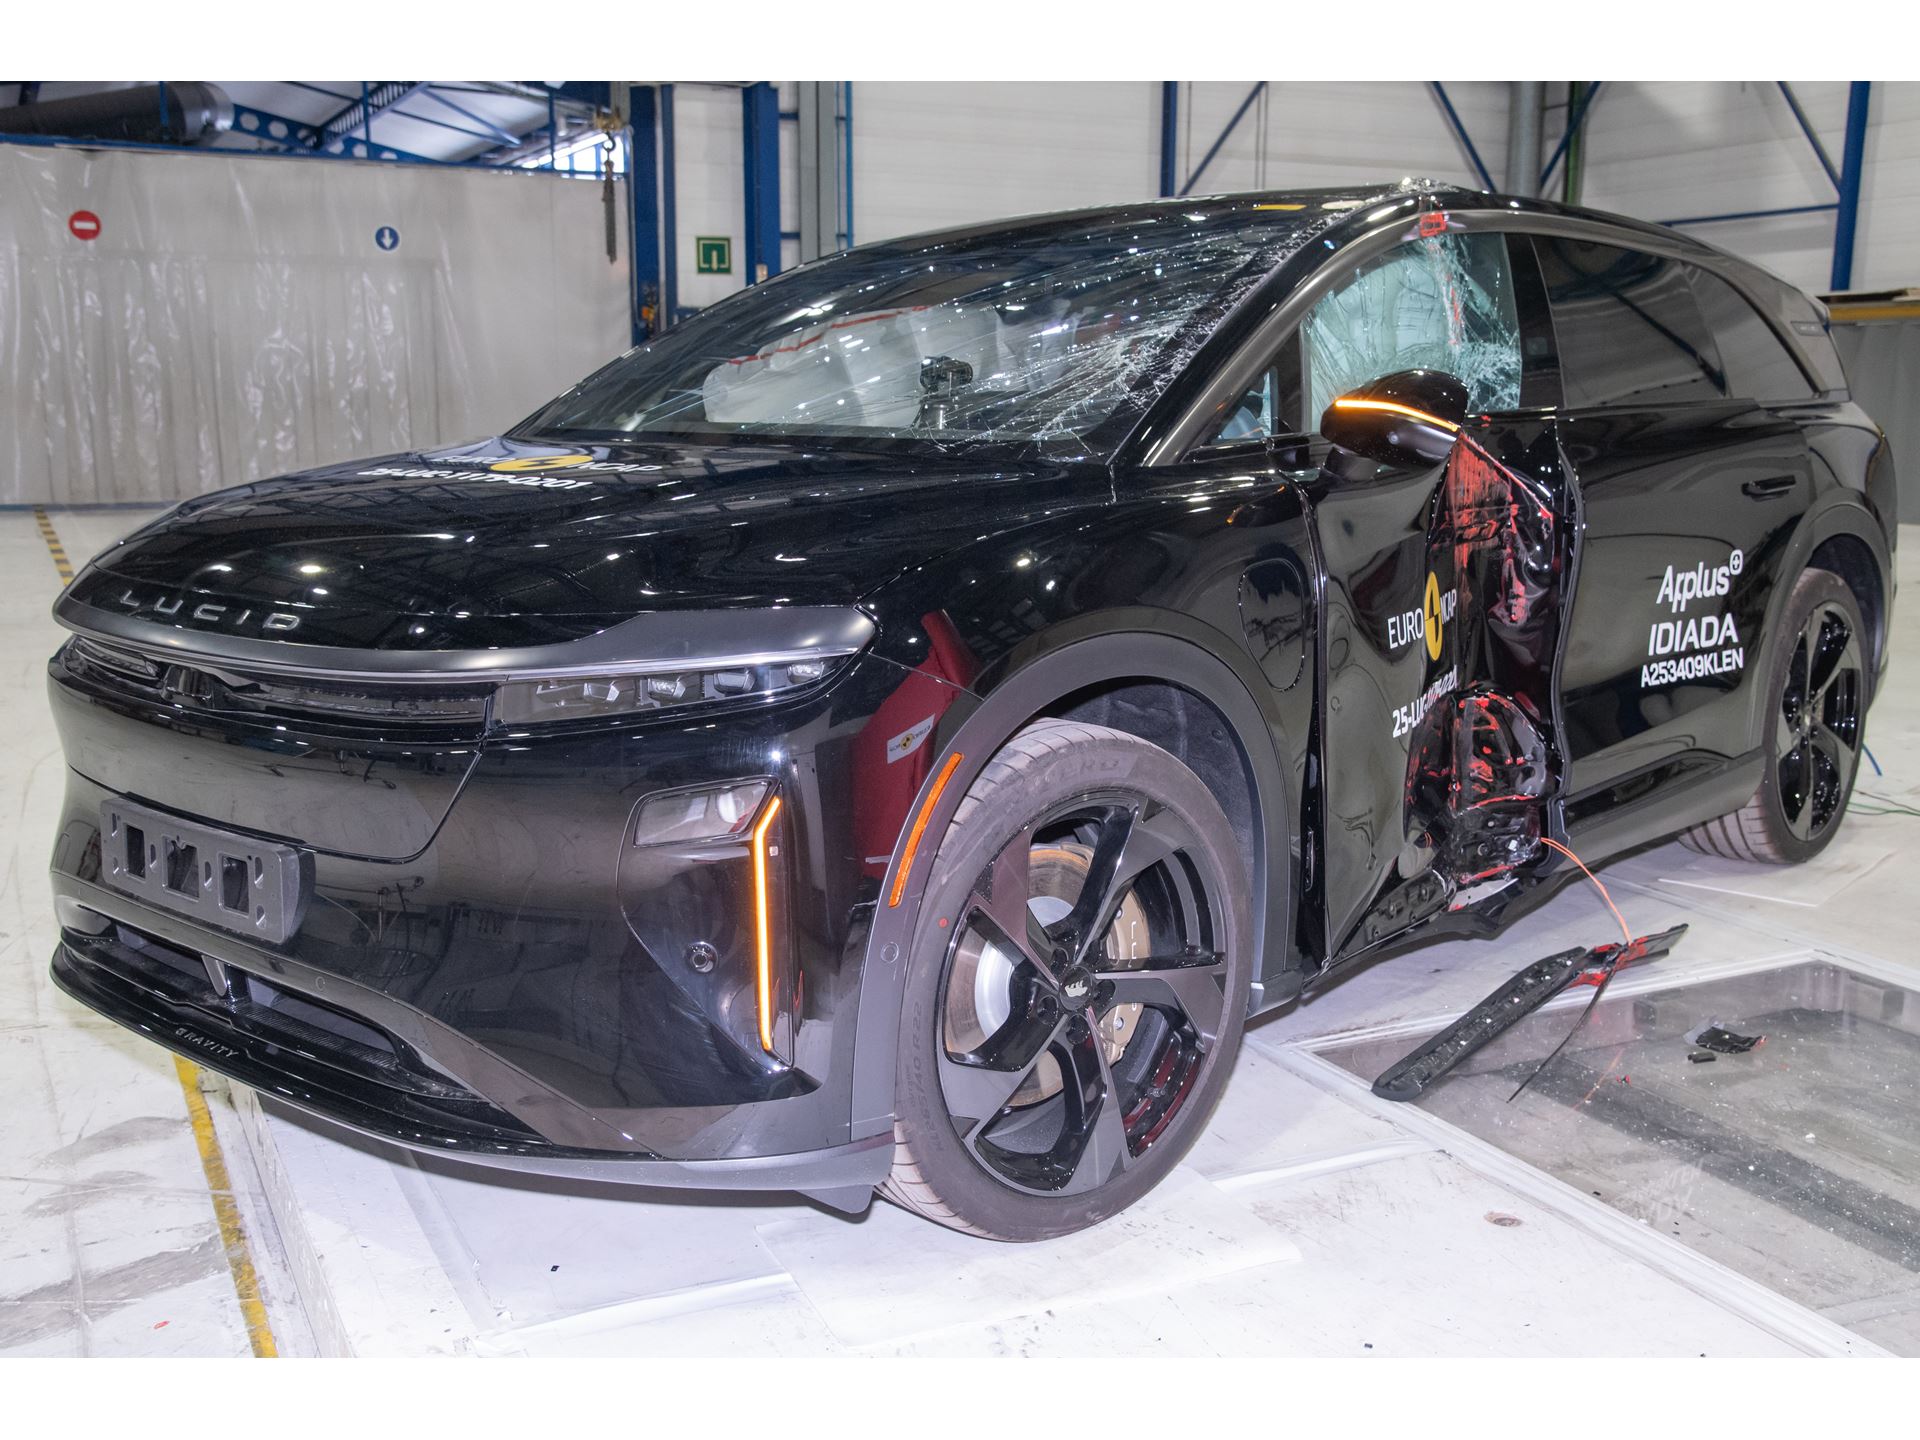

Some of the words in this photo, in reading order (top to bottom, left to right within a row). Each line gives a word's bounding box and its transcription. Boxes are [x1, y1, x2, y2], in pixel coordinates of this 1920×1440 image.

[120, 590, 300, 631] LUCID
[1387, 608, 1425, 649] EURO
[1439, 588, 1457, 625] NCAP
[1648, 612, 1739, 656] IDIADA
[1641, 647, 1744, 688] A253409KLEN
[175, 1027, 239, 1057] GRAVITY
